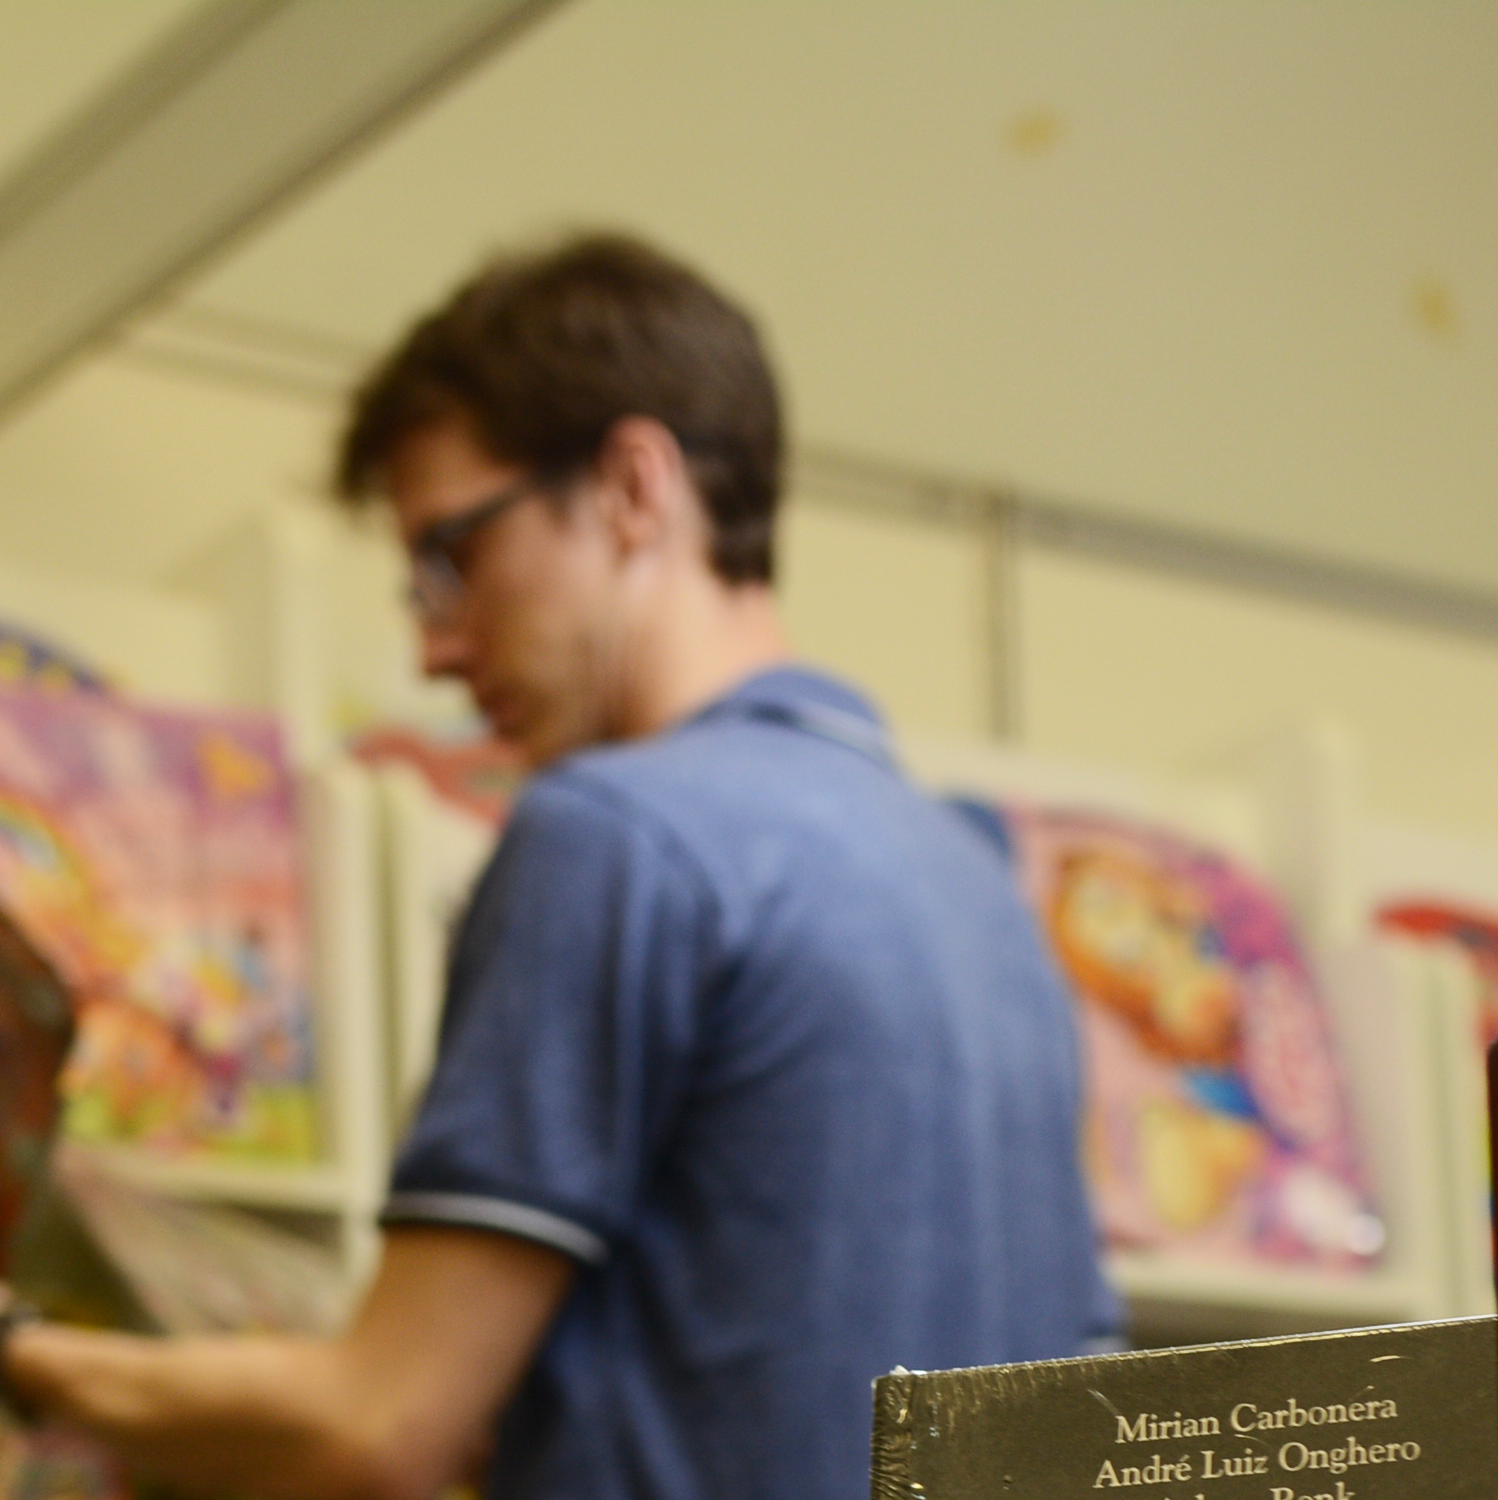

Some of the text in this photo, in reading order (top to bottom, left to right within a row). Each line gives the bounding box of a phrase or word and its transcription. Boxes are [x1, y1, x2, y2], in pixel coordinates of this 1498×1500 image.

[1115, 1398, 1398, 1443] Mirian Carbonera
[1093, 1437, 1421, 1488] André Luiz Onghero
